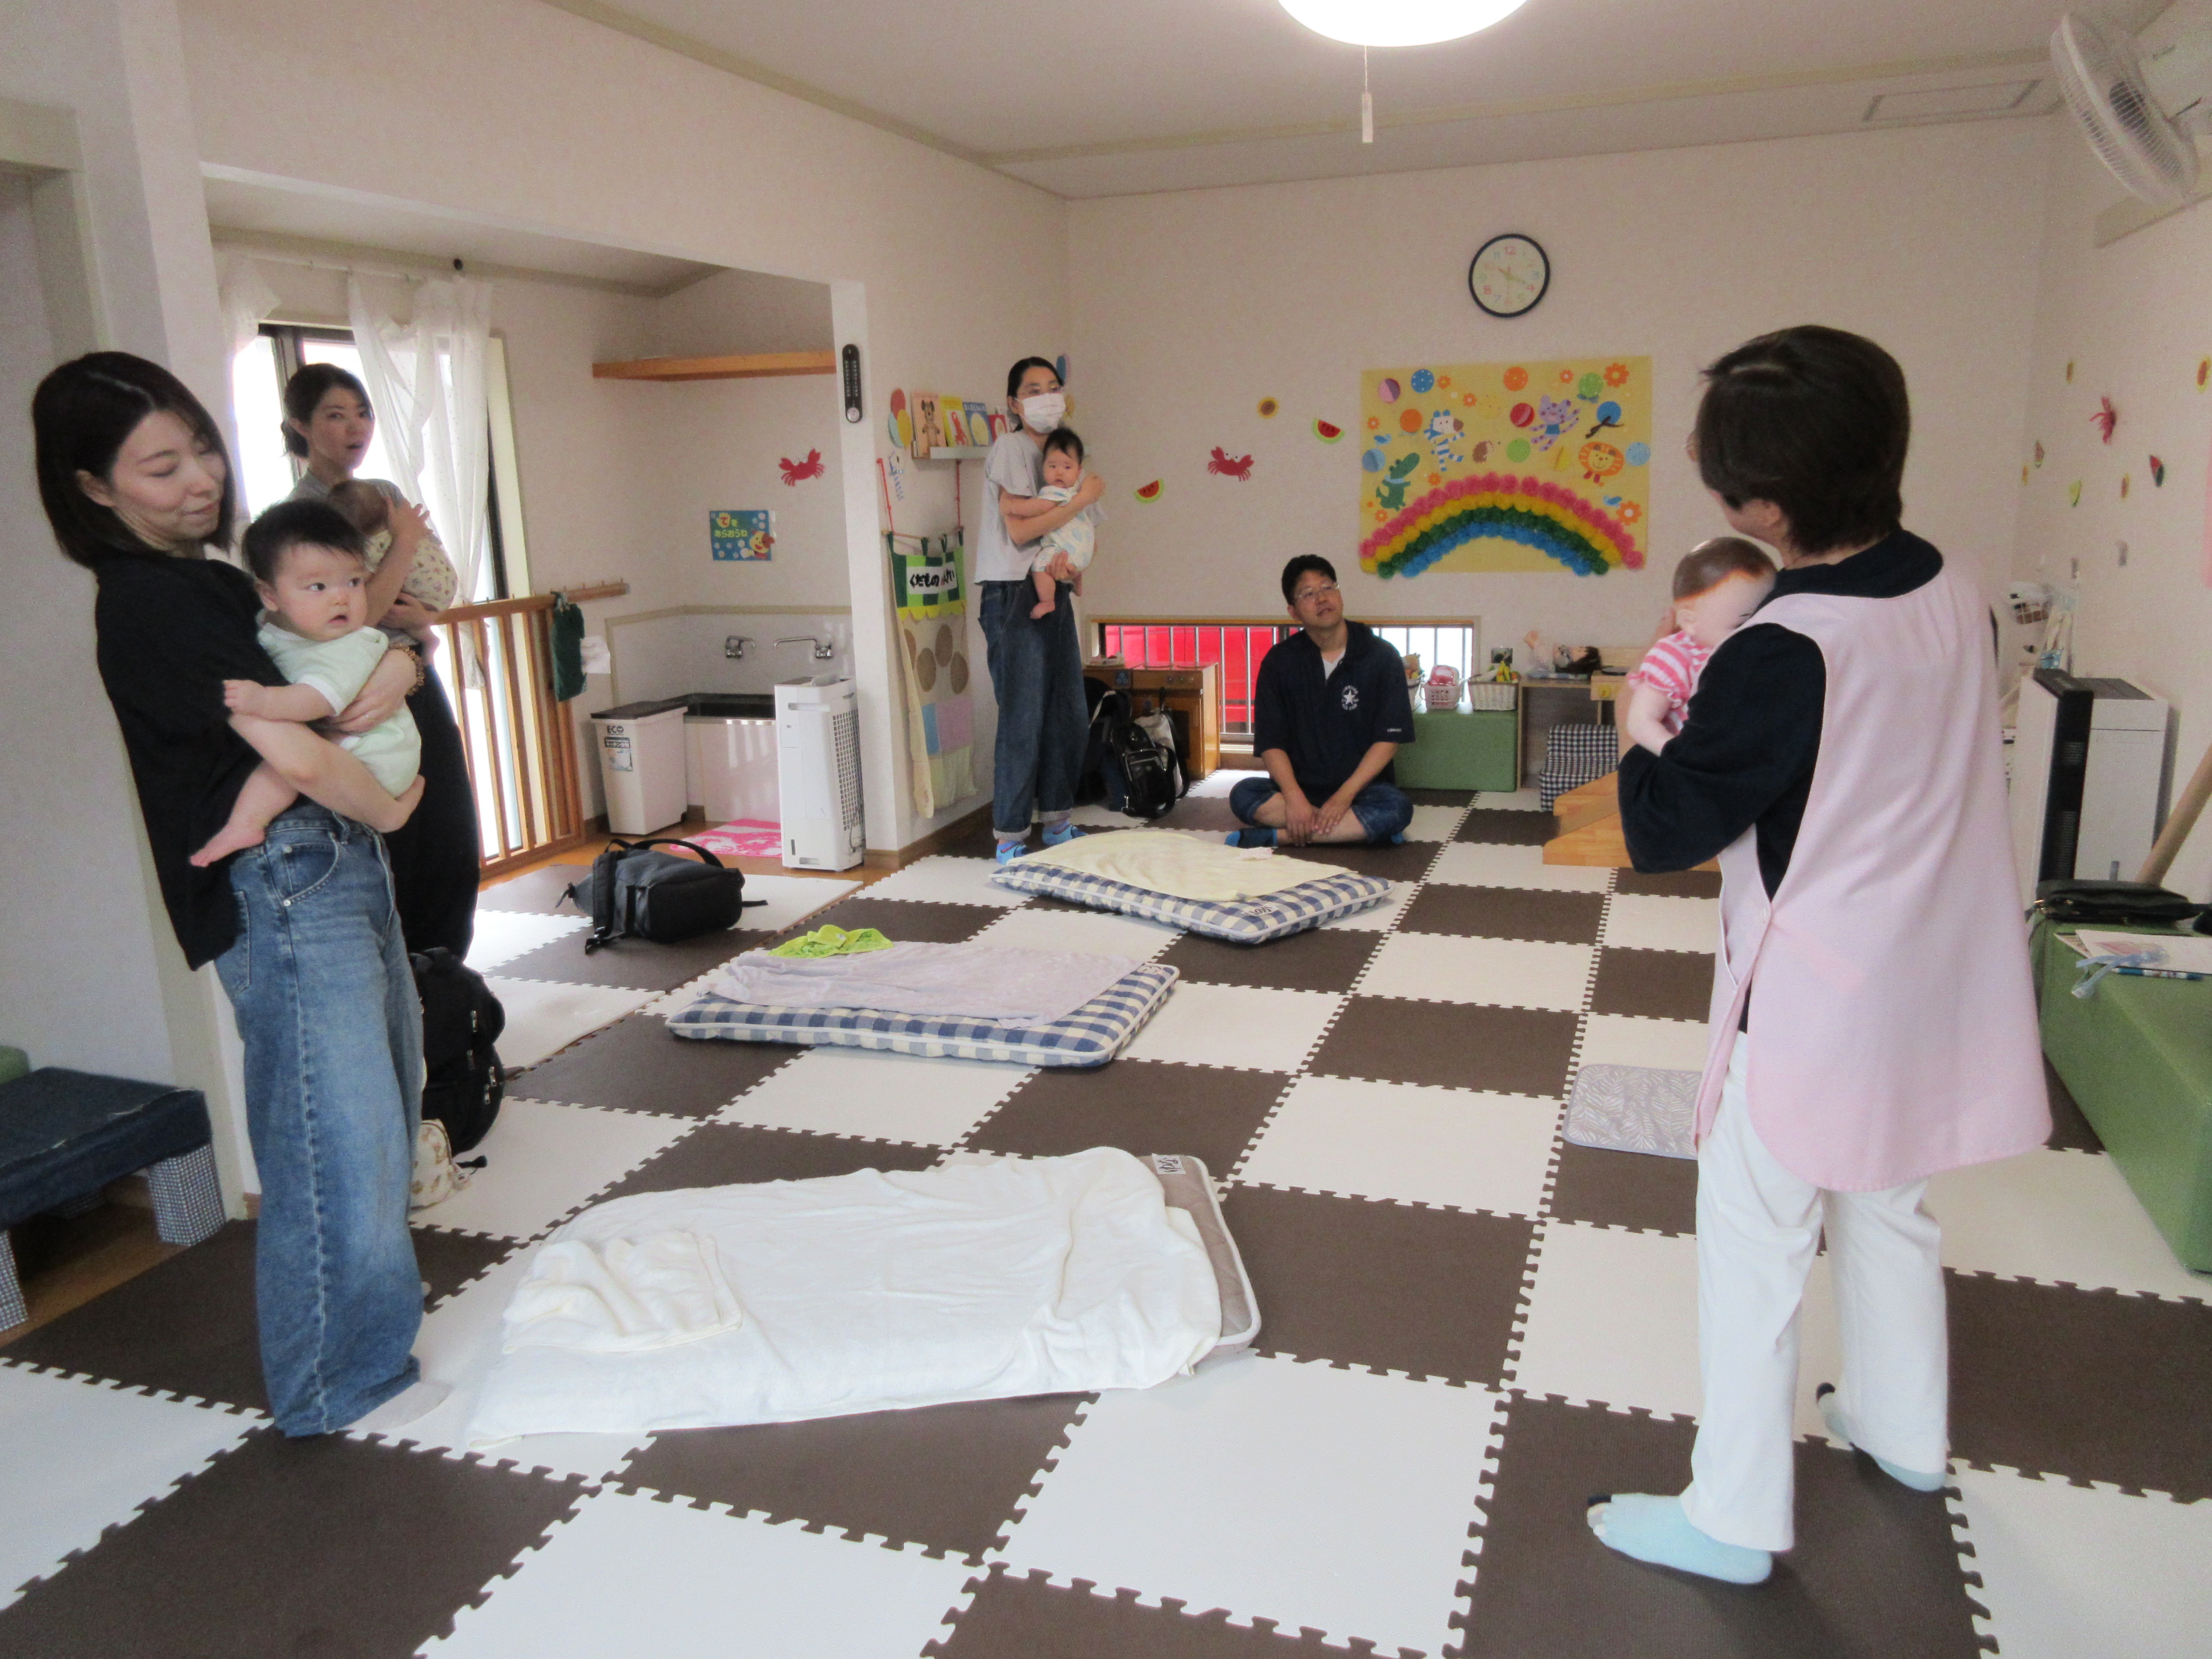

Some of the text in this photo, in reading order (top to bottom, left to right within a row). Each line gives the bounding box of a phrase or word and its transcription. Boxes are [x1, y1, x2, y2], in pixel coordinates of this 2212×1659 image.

[1483, 285, 1492, 295] 8
[715, 530, 748, 538] あらおうね
